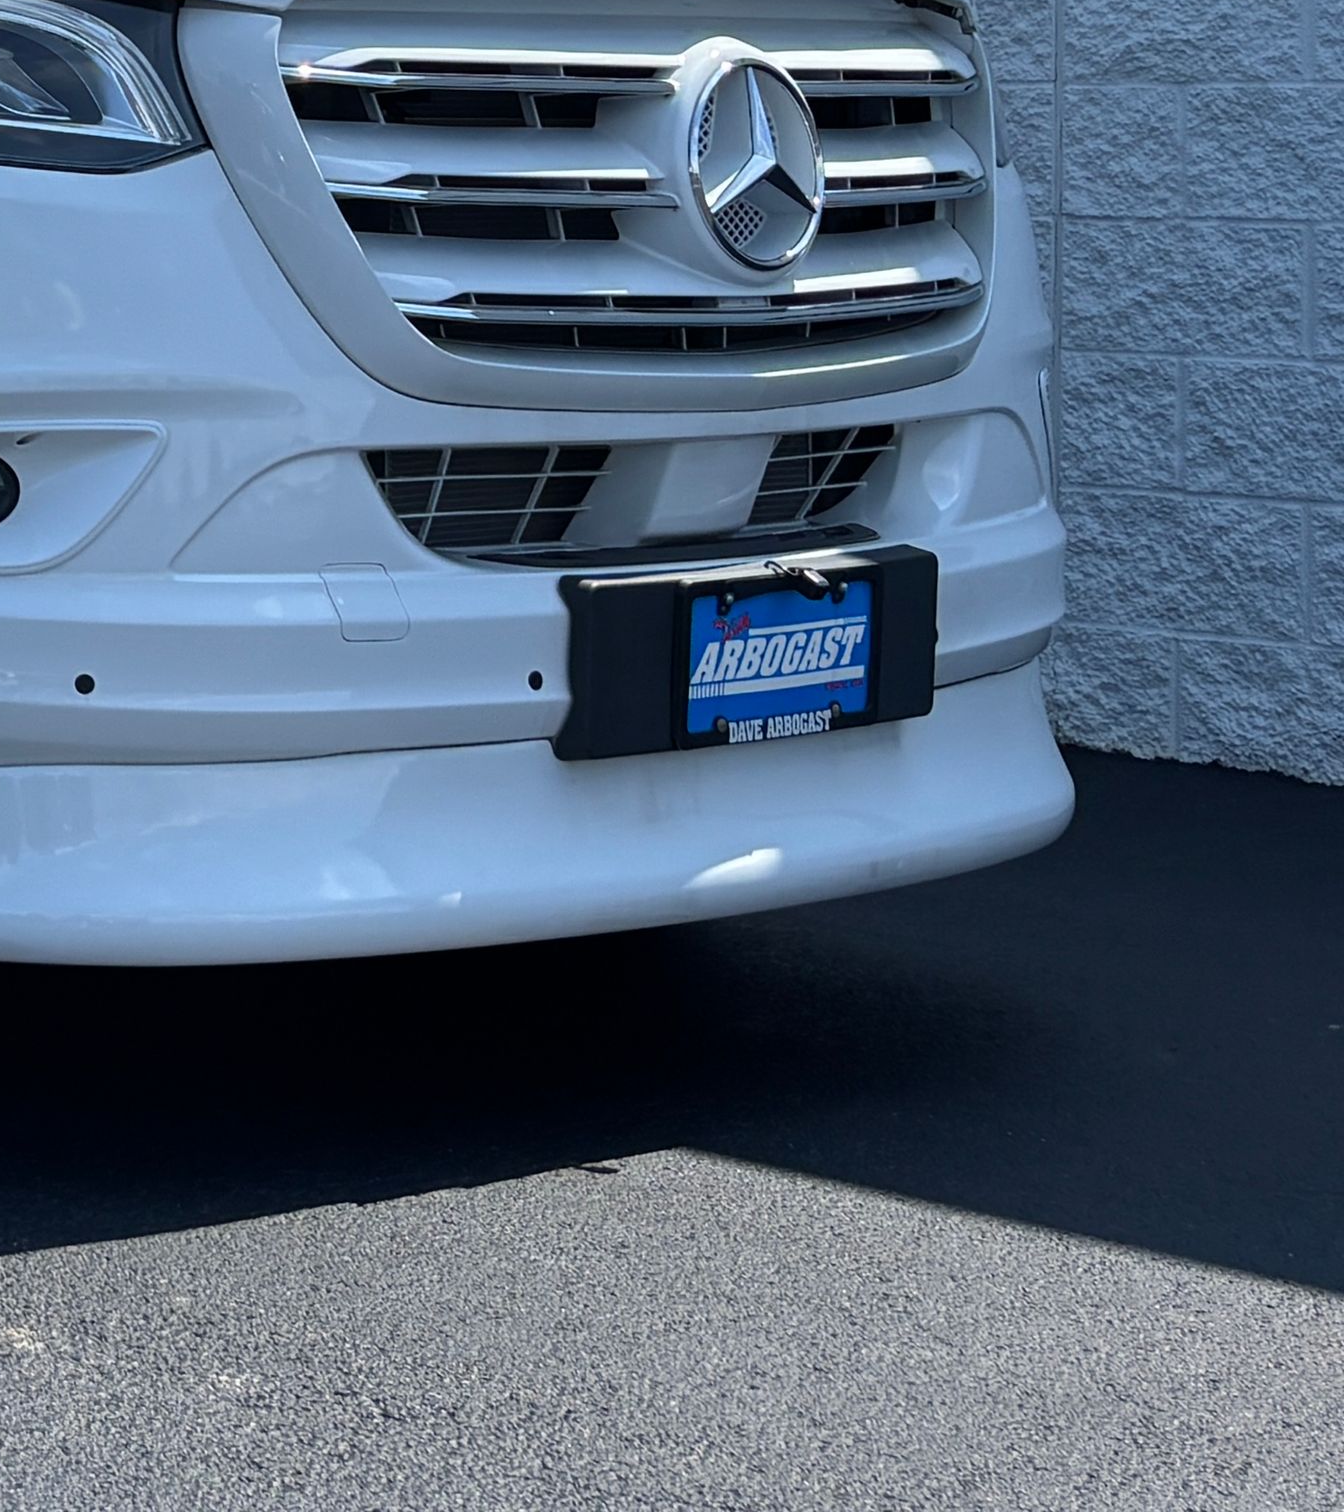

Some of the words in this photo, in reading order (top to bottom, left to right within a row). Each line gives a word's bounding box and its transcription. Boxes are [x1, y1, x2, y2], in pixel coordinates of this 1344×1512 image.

[691, 625, 865, 683] ARBOGAST
[729, 719, 763, 743] DAVE
[767, 709, 832, 738] ARBOGAST
